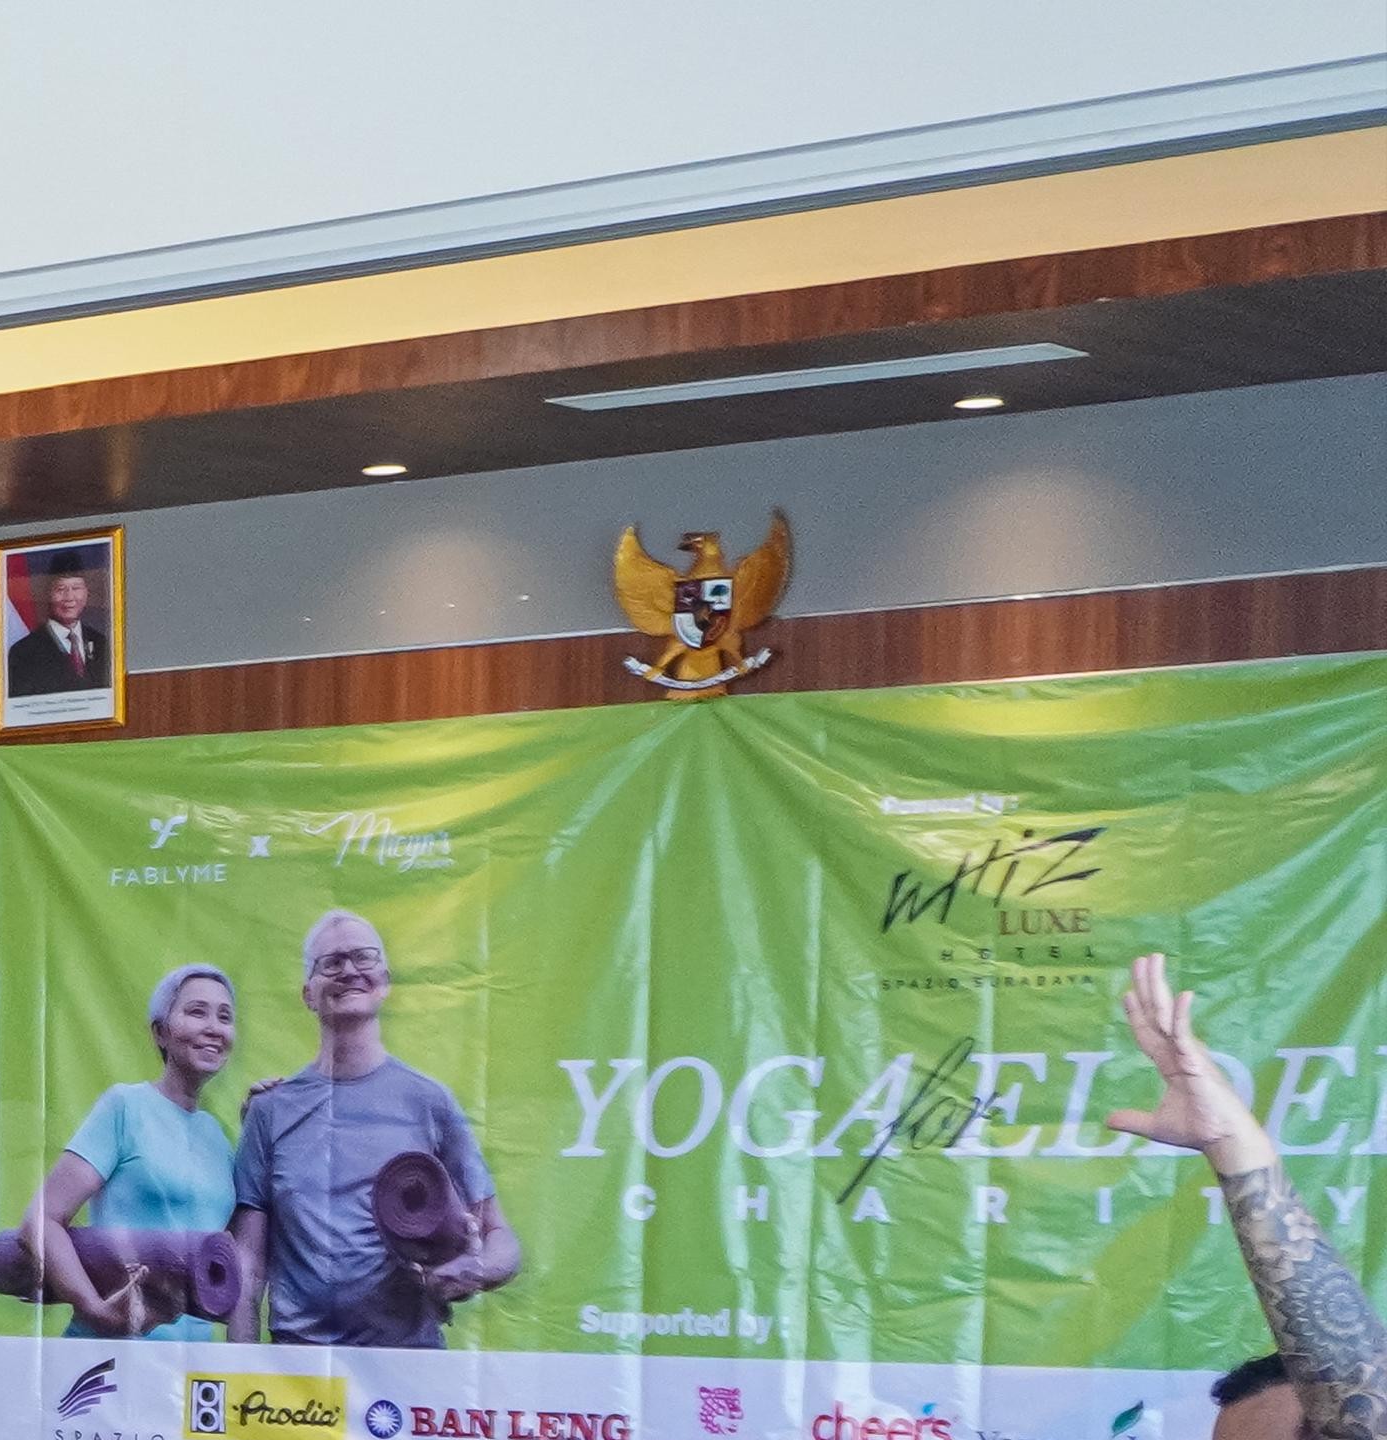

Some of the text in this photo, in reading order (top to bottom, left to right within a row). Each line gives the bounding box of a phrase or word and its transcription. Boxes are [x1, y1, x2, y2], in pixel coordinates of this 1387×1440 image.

[110, 863, 227, 887] FABLYME
[998, 908, 1091, 936] LUXE
[556, 1053, 915, 1158] YOGA
[835, 1036, 1000, 1204] for
[579, 1304, 731, 1340] Supported
[736, 1309, 772, 1344] by
[238, 1390, 338, 1427] Prodia
[410, 1406, 497, 1439] BAN
